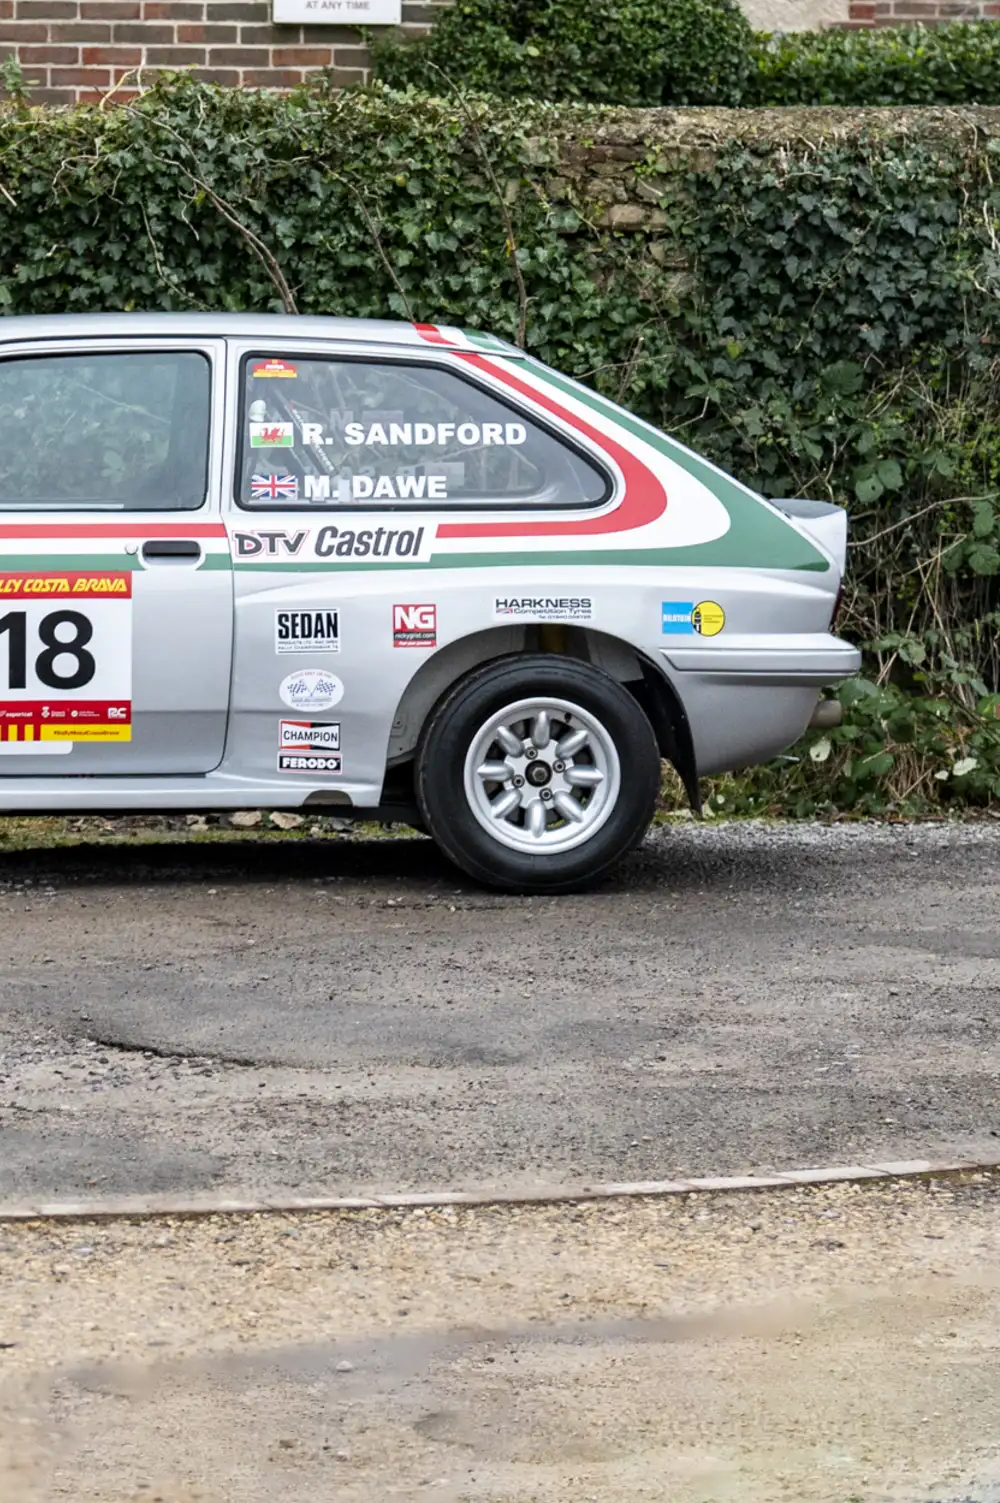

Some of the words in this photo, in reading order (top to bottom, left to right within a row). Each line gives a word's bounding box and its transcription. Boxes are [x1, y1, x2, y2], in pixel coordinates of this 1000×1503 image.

[305, 1, 317, 10] AT
[320, 1, 342, 10] ANY
[345, 1, 370, 10] TIME
[302, 423, 334, 445] R.
[344, 423, 527, 445] SANDFORD
[304, 475, 341, 498] M.
[352, 475, 448, 498] DAWE
[233, 530, 308, 557] DTV
[314, 525, 425, 557] Castrol
[23, 578, 70, 593] COSTA
[72, 577, 128, 592] BRAVA
[495, 598, 592, 608] HARKNESS
[278, 612, 338, 639] SEDAN
[394, 606, 435, 629] NG
[283, 730, 338, 742] CHAMPION
[282, 757, 337, 769] FERODO
